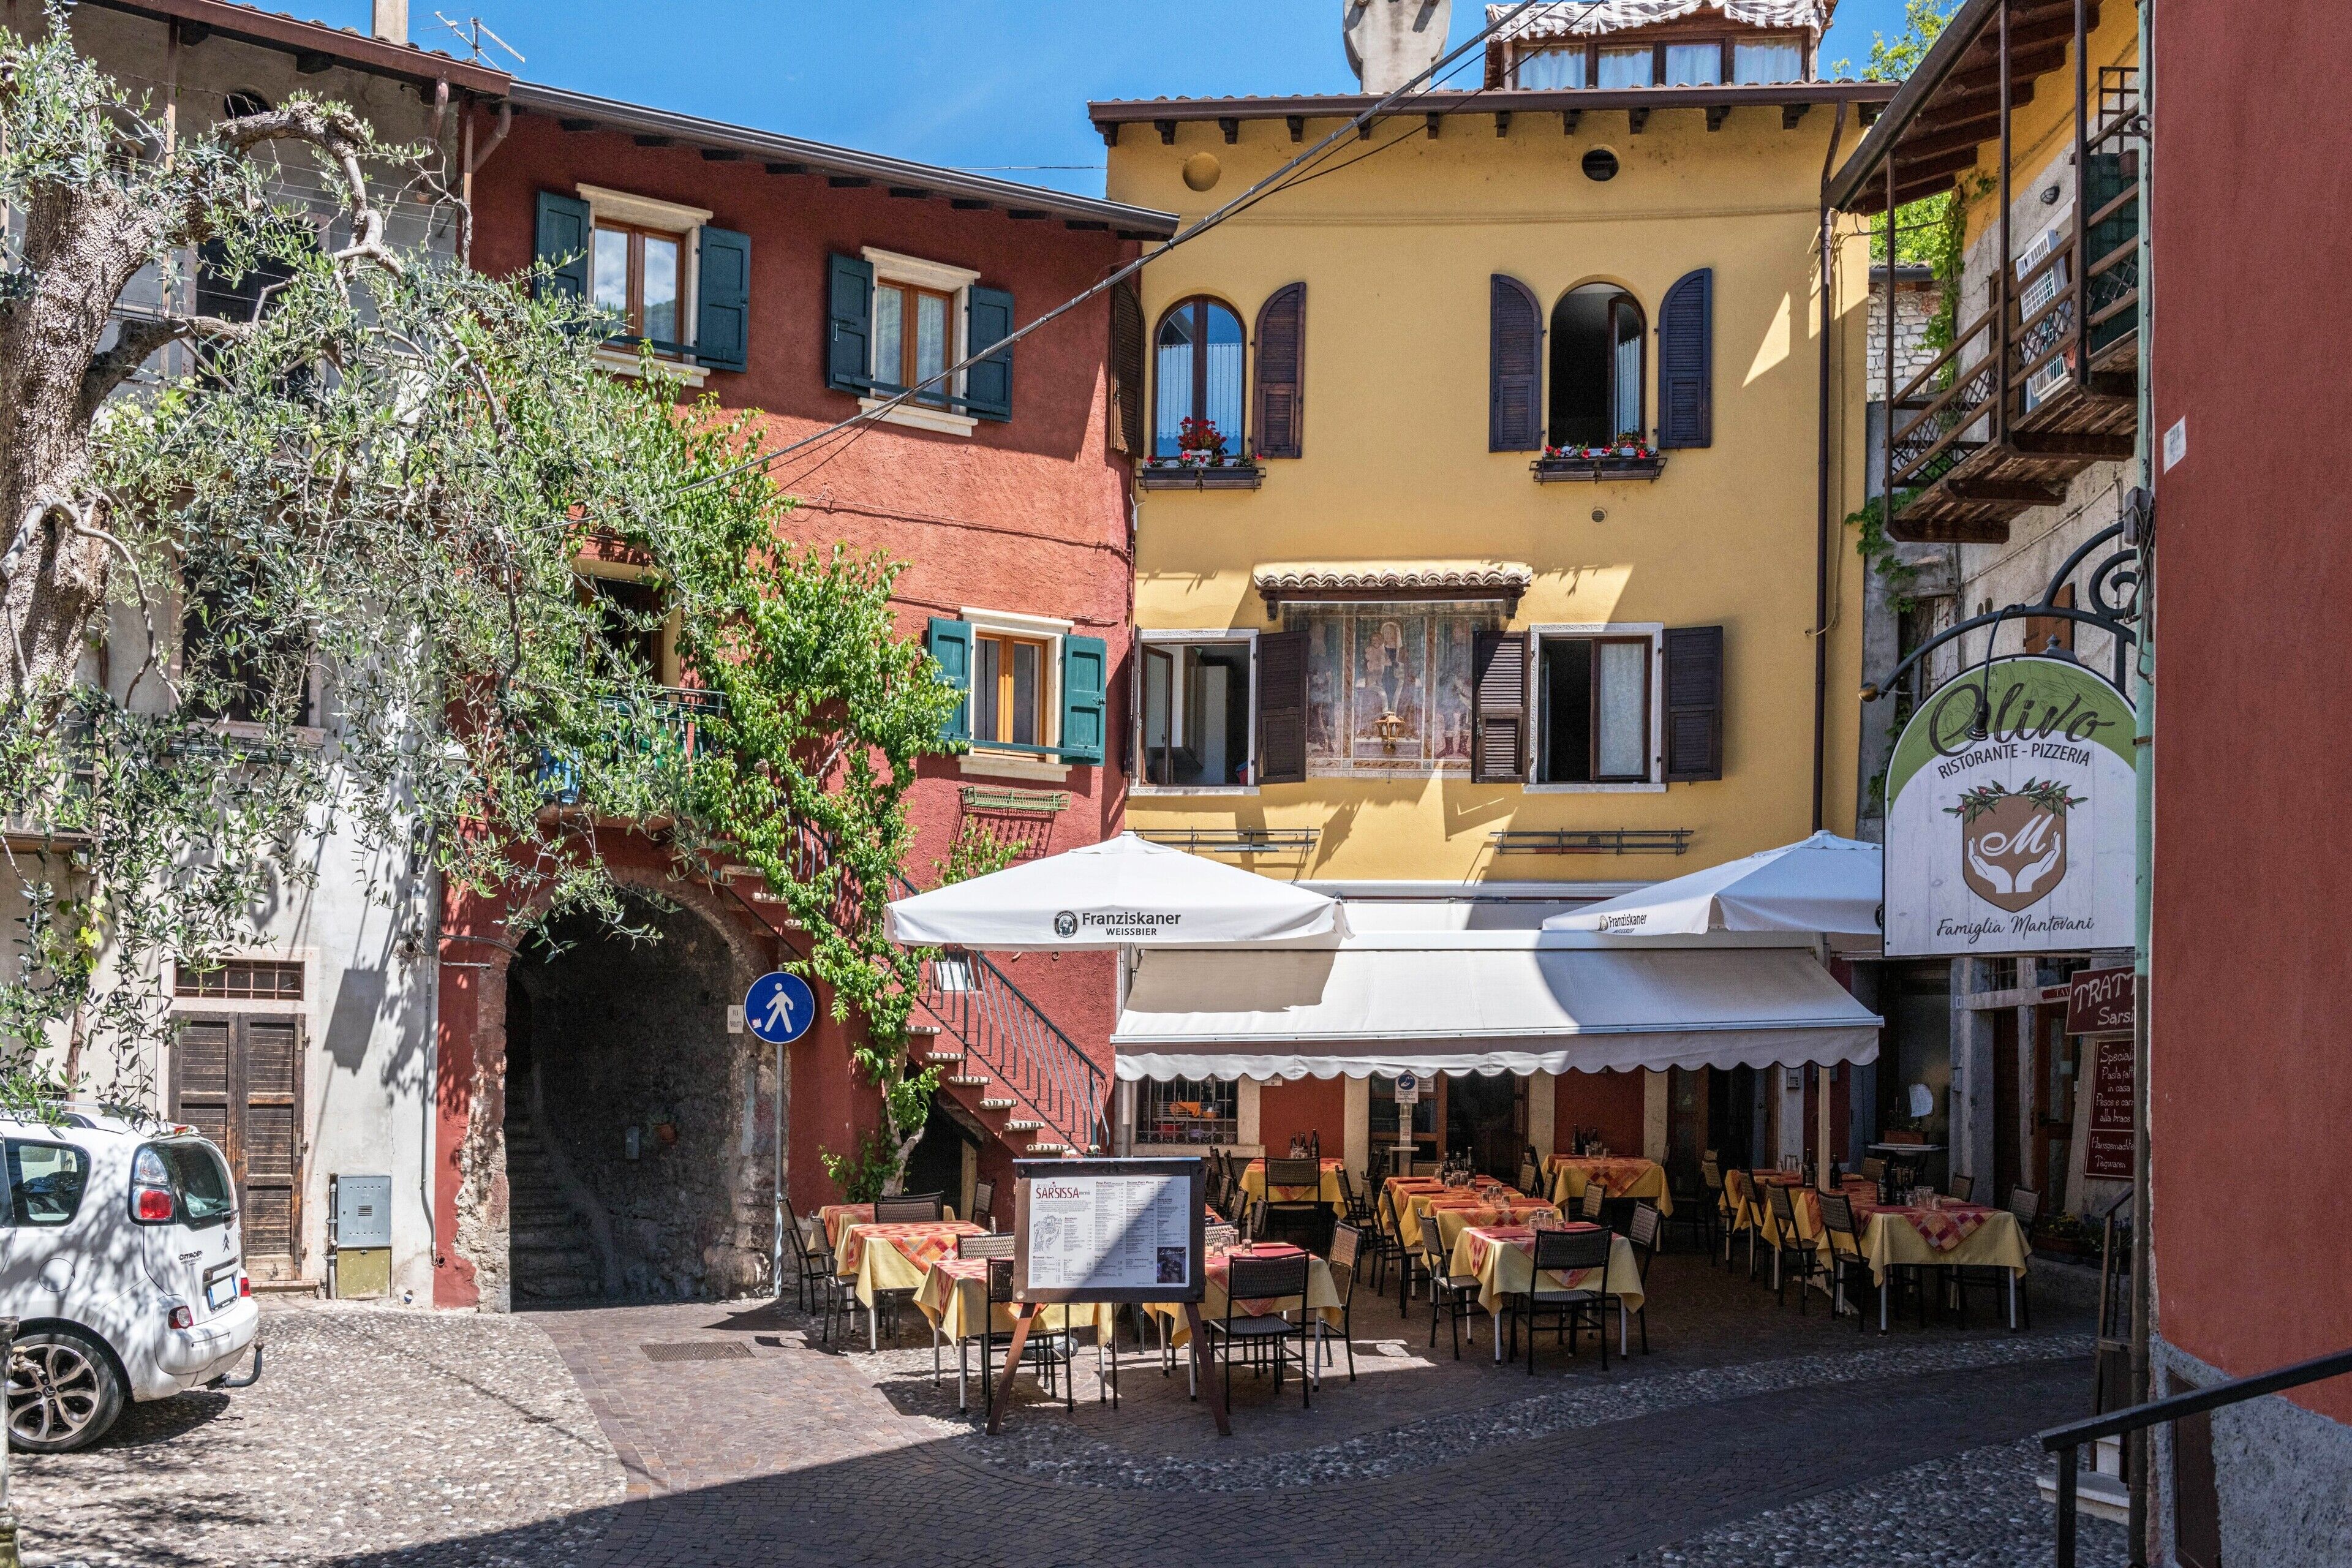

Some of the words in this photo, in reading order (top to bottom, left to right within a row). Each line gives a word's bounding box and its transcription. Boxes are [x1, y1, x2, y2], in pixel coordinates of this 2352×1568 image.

[1930, 683, 2116, 757] Olivo
[1937, 744, 2018, 779] RISTORANTE
[2031, 742, 2090, 766] PIZZERIA
[1082, 911, 1182, 925] Franziskaner
[1608, 914, 1648, 928] Franziskaner
[1937, 918, 2005, 944] Famiglia
[2010, 914, 2095, 940] Mantovani
[2102, 1066, 2121, 1080] Pasta
[2108, 1083, 2114, 1092] in
[2096, 1093, 2114, 1106] Pesce
[2100, 1108, 2111, 1123] alla
[2113, 1109, 2131, 1123] brace
[2095, 1155, 2126, 1170] Teigwaren
[1036, 1187, 1079, 1199] SARSISSA
